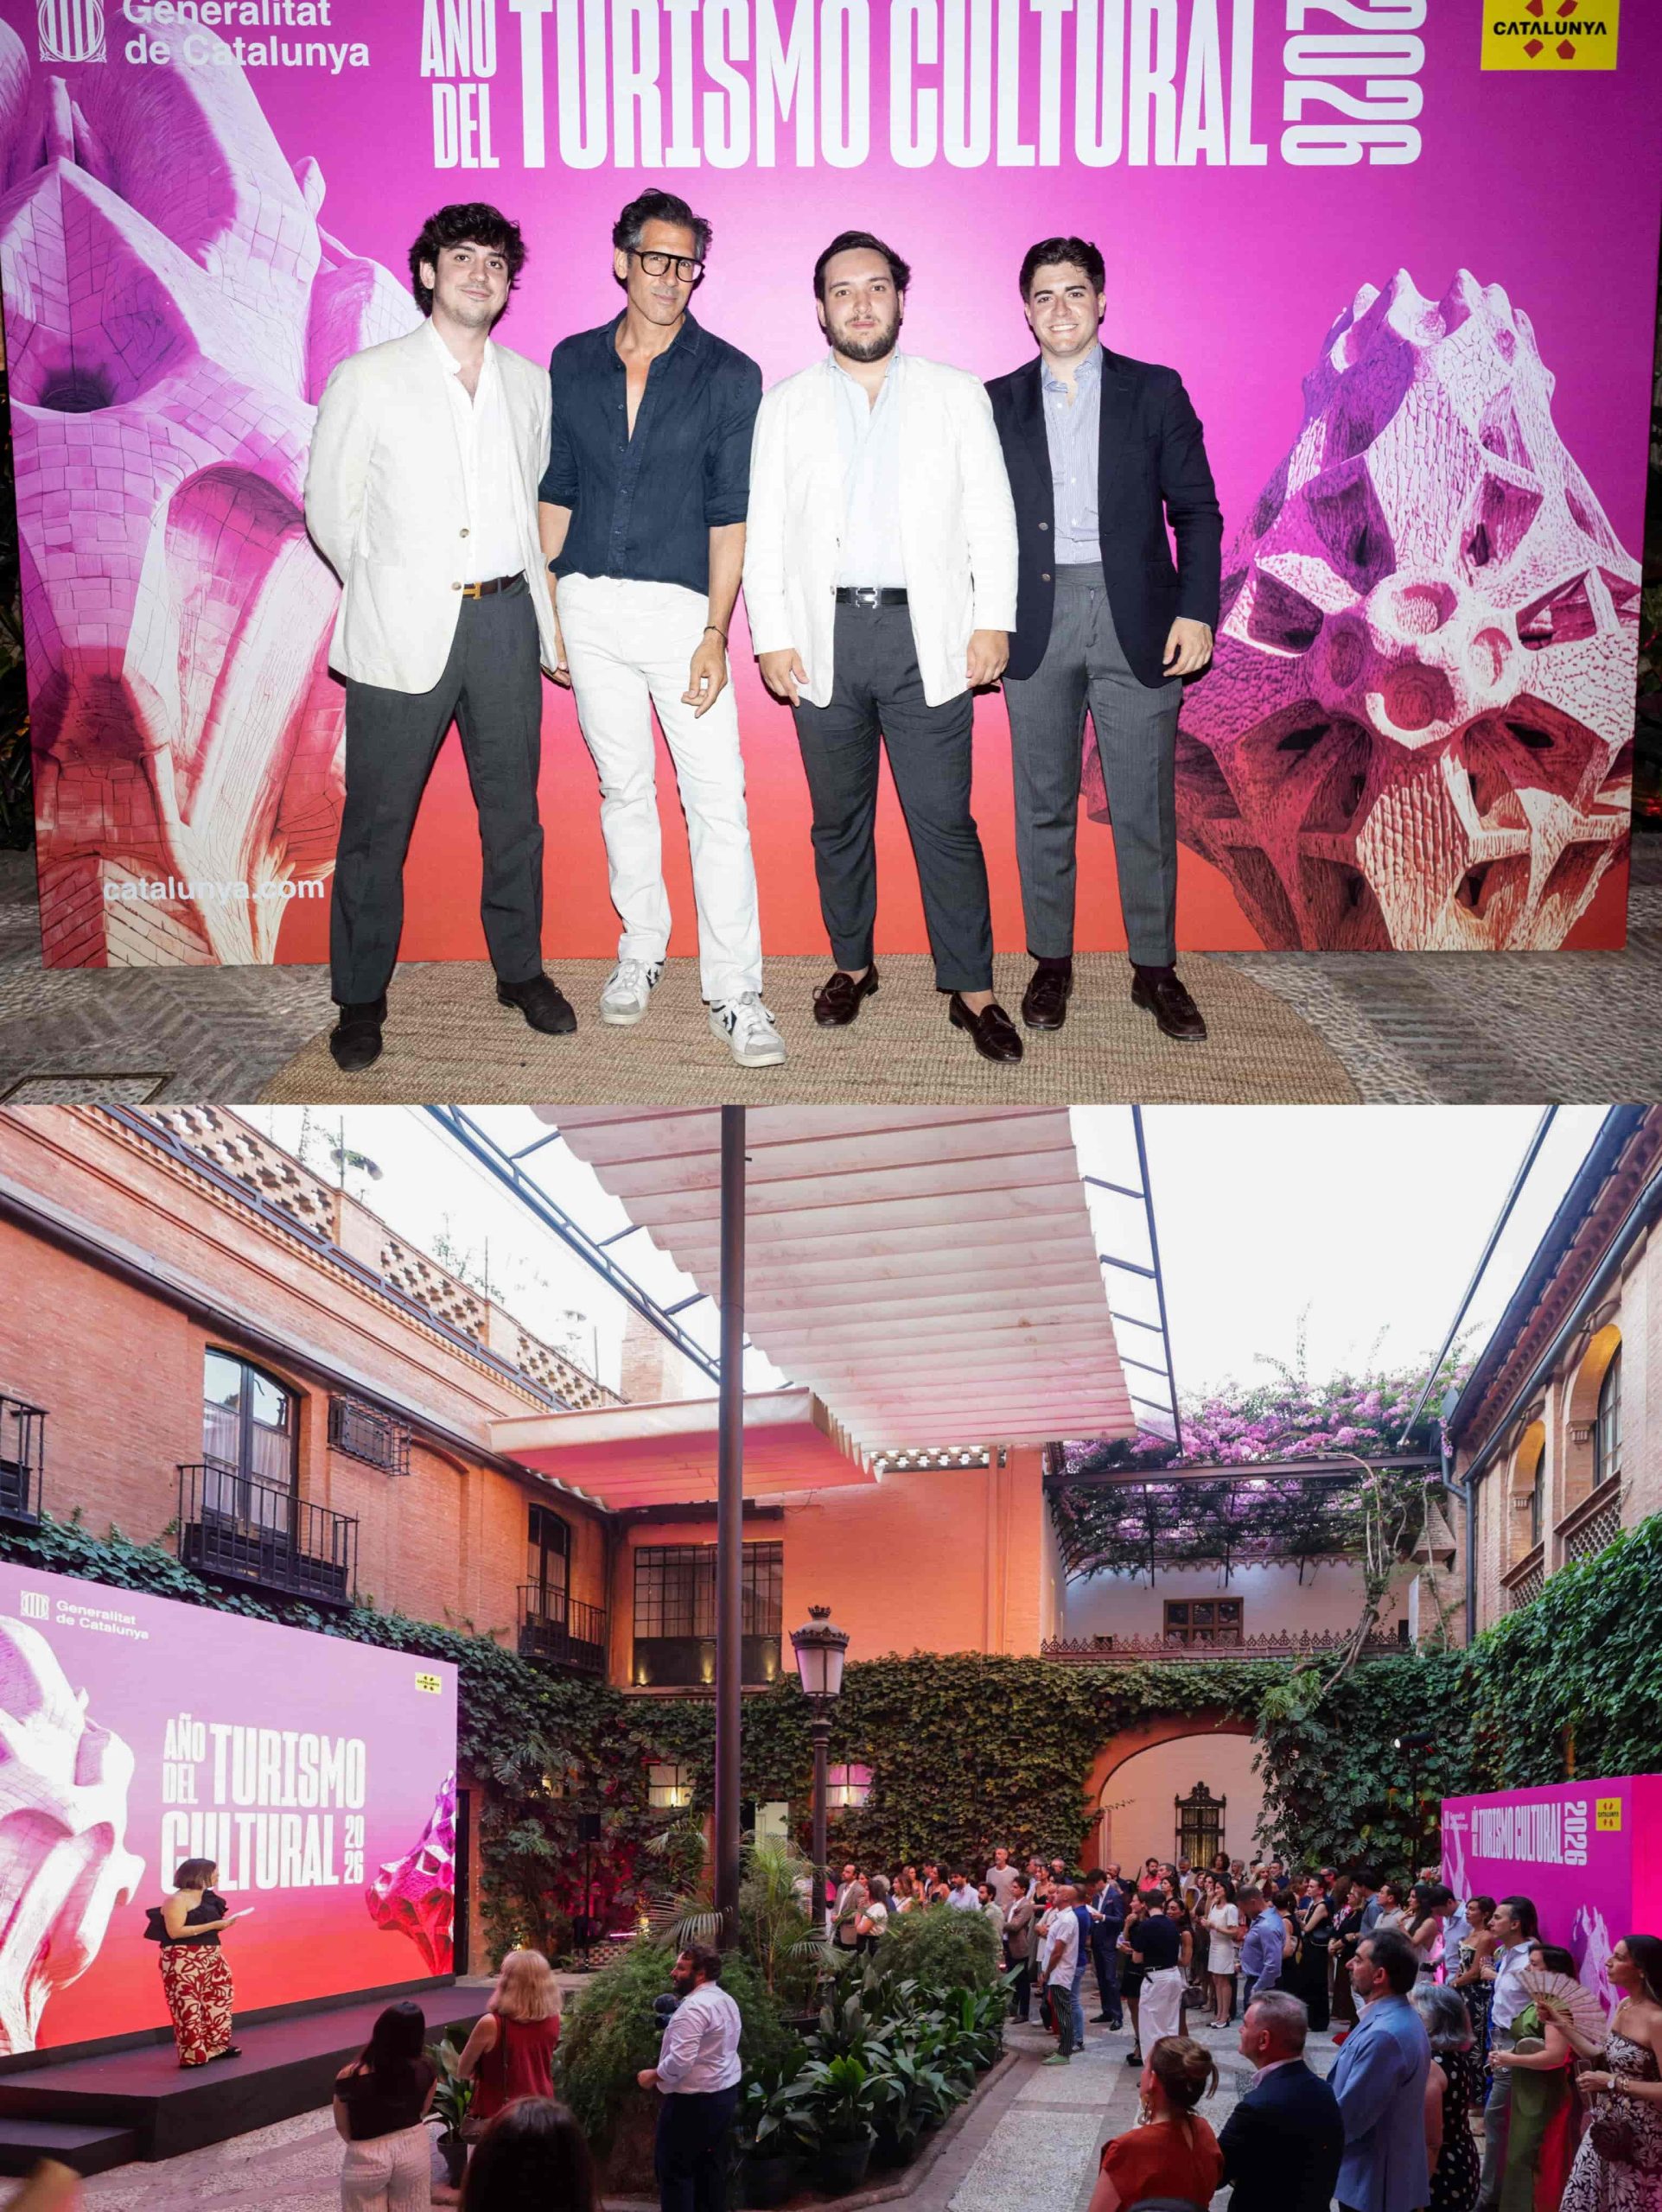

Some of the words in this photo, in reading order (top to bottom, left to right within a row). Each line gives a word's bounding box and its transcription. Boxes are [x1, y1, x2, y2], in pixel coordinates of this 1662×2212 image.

[123, 0, 332, 26] Generalitat
[1493, 22, 1607, 35] CATALUNYA
[124, 34, 170, 65] de
[182, 34, 370, 75] Catalunya
[509, 0, 869, 168] TURISMO
[890, 0, 1268, 168] CULTURAL
[1281, 0, 1428, 166] 2026
[432, 83, 500, 168] DEL
[104, 876, 325, 906] catalunya.com
[56, 1600, 136, 1625] Generalitat
[56, 1613, 75, 1626] de
[80, 1617, 149, 1640] Catalunya
[163, 1712, 206, 1763] AÑO
[162, 1762, 199, 1804] DEL
[209, 1723, 366, 1809] TURISMO
[161, 1810, 340, 1895] CULTURAL
[344, 1815, 365, 1849] 20
[1479, 1806, 1513, 1860] TURISMO
[1515, 1802, 1563, 1864] CULTURAL
[1564, 1801, 1588, 1866] 2026
[344, 1850, 365, 1885] 26
